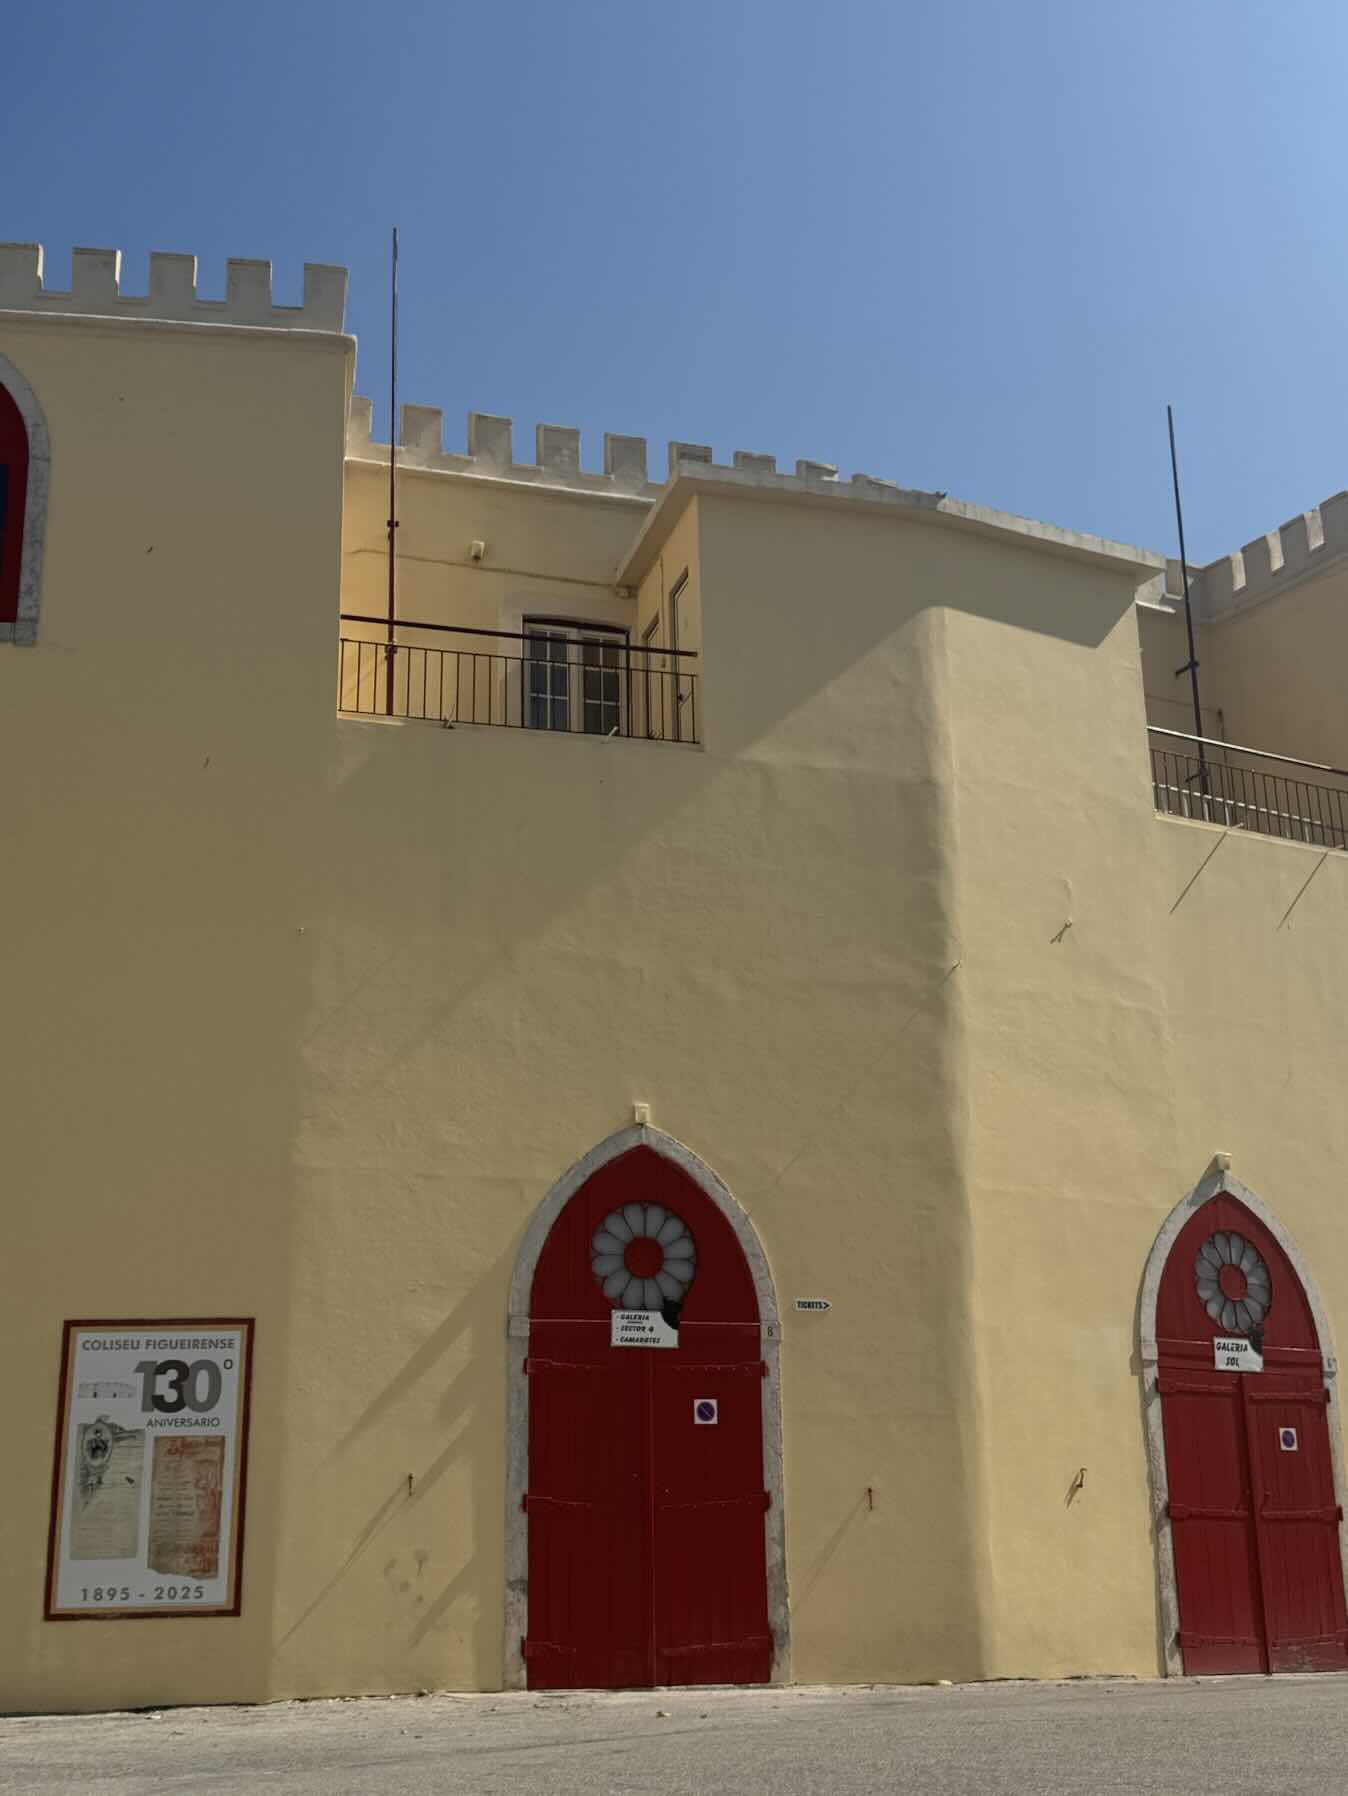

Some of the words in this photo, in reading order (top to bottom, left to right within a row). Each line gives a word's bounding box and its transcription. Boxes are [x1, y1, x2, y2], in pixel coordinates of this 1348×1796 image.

[82, 1339, 140, 1351] COLISEU
[145, 1338, 235, 1350] FIGUEIRENSE
[1216, 1342, 1248, 1352] GALERIA
[1225, 1357, 1239, 1368] SOL
[81, 1587, 131, 1602] 1895
[153, 1586, 205, 1600] 2025
